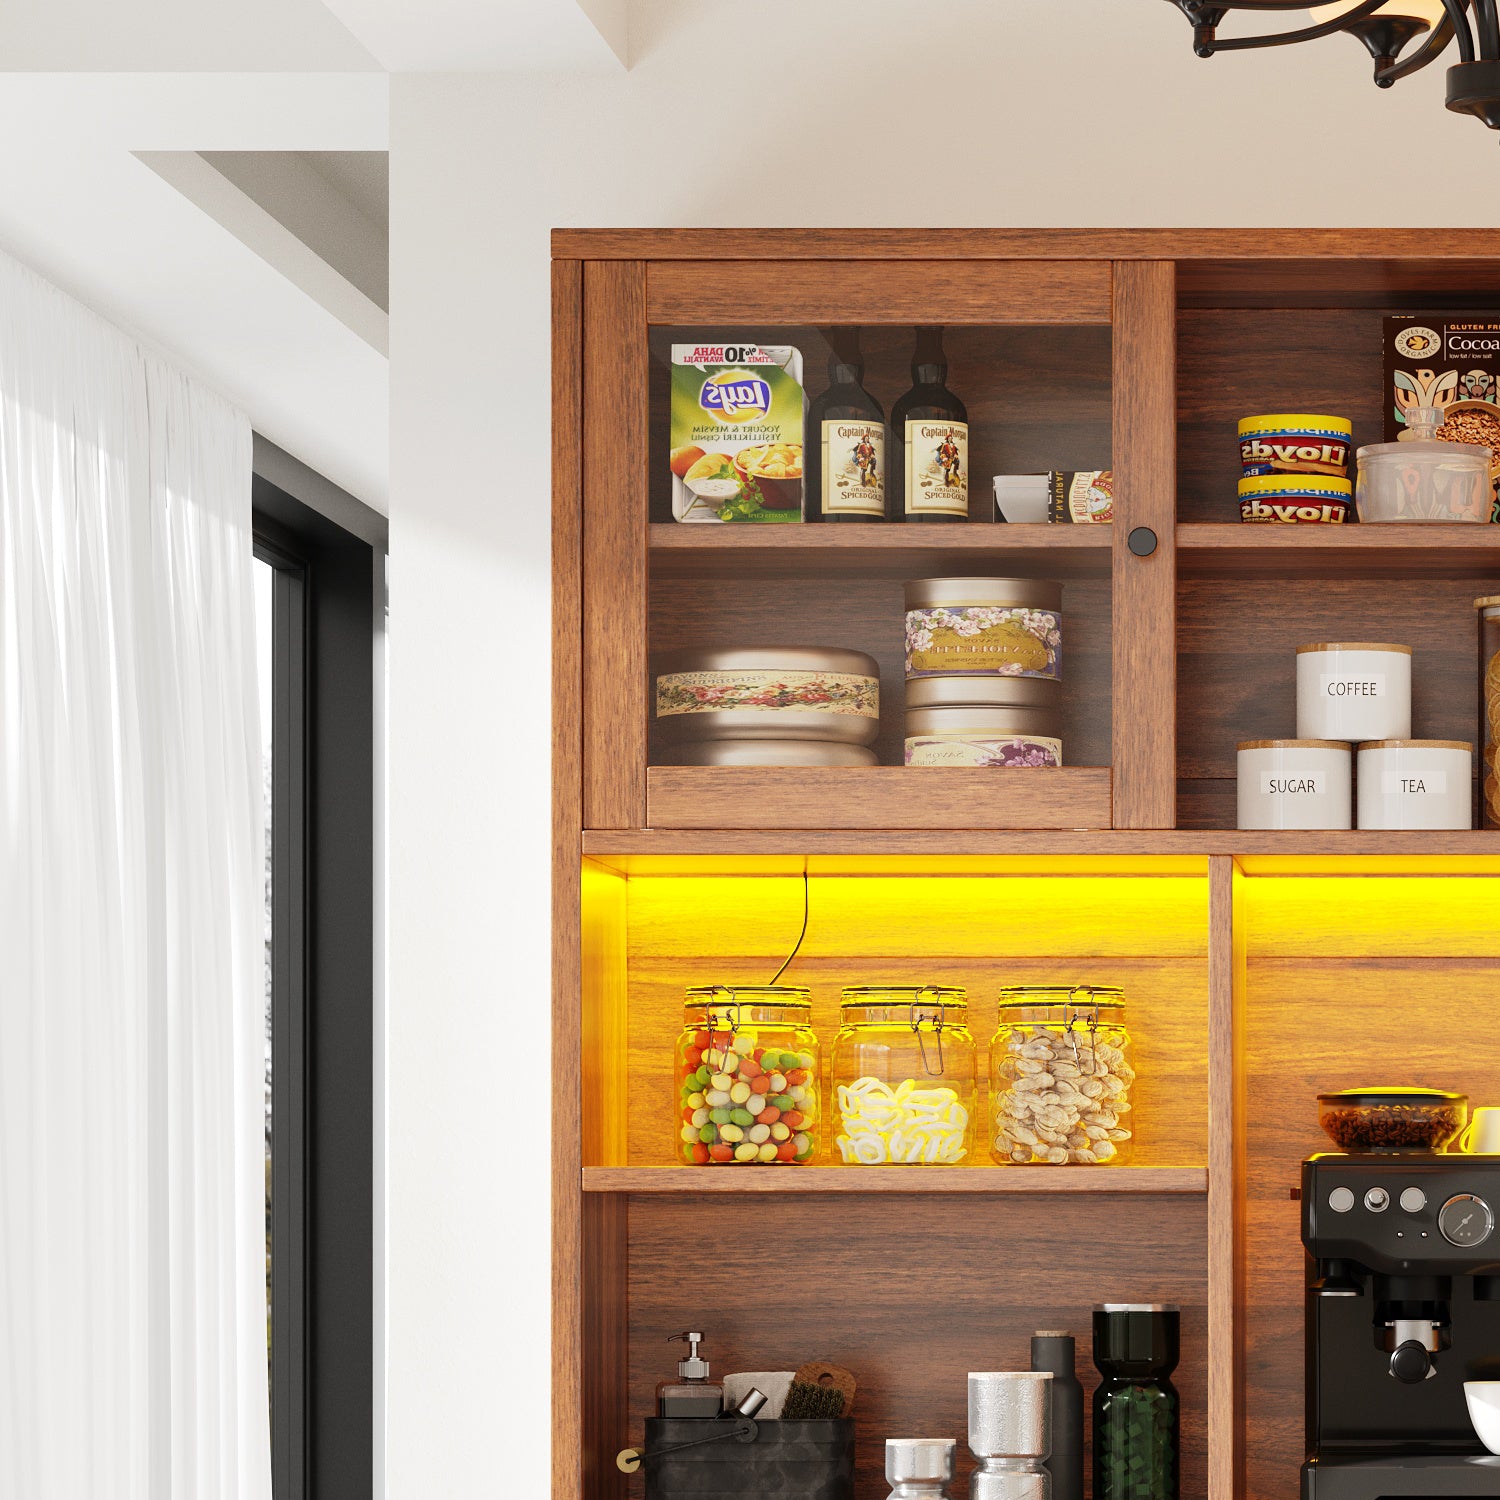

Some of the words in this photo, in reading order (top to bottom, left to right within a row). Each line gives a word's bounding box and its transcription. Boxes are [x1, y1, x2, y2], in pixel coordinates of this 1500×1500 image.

[1421, 329, 1438, 344] FARM
[1448, 336, 1500, 350] Cocoa
[1400, 346, 1435, 357] ORGANIC
[837, 426, 864, 439] Captain
[921, 426, 948, 439] Captain
[841, 491, 868, 500] SPICED
[924, 491, 950, 500] SPICED
[1327, 682, 1377, 696] COFFEE
[1269, 779, 1315, 794] SUGAR
[1400, 780, 1426, 793] TEA
